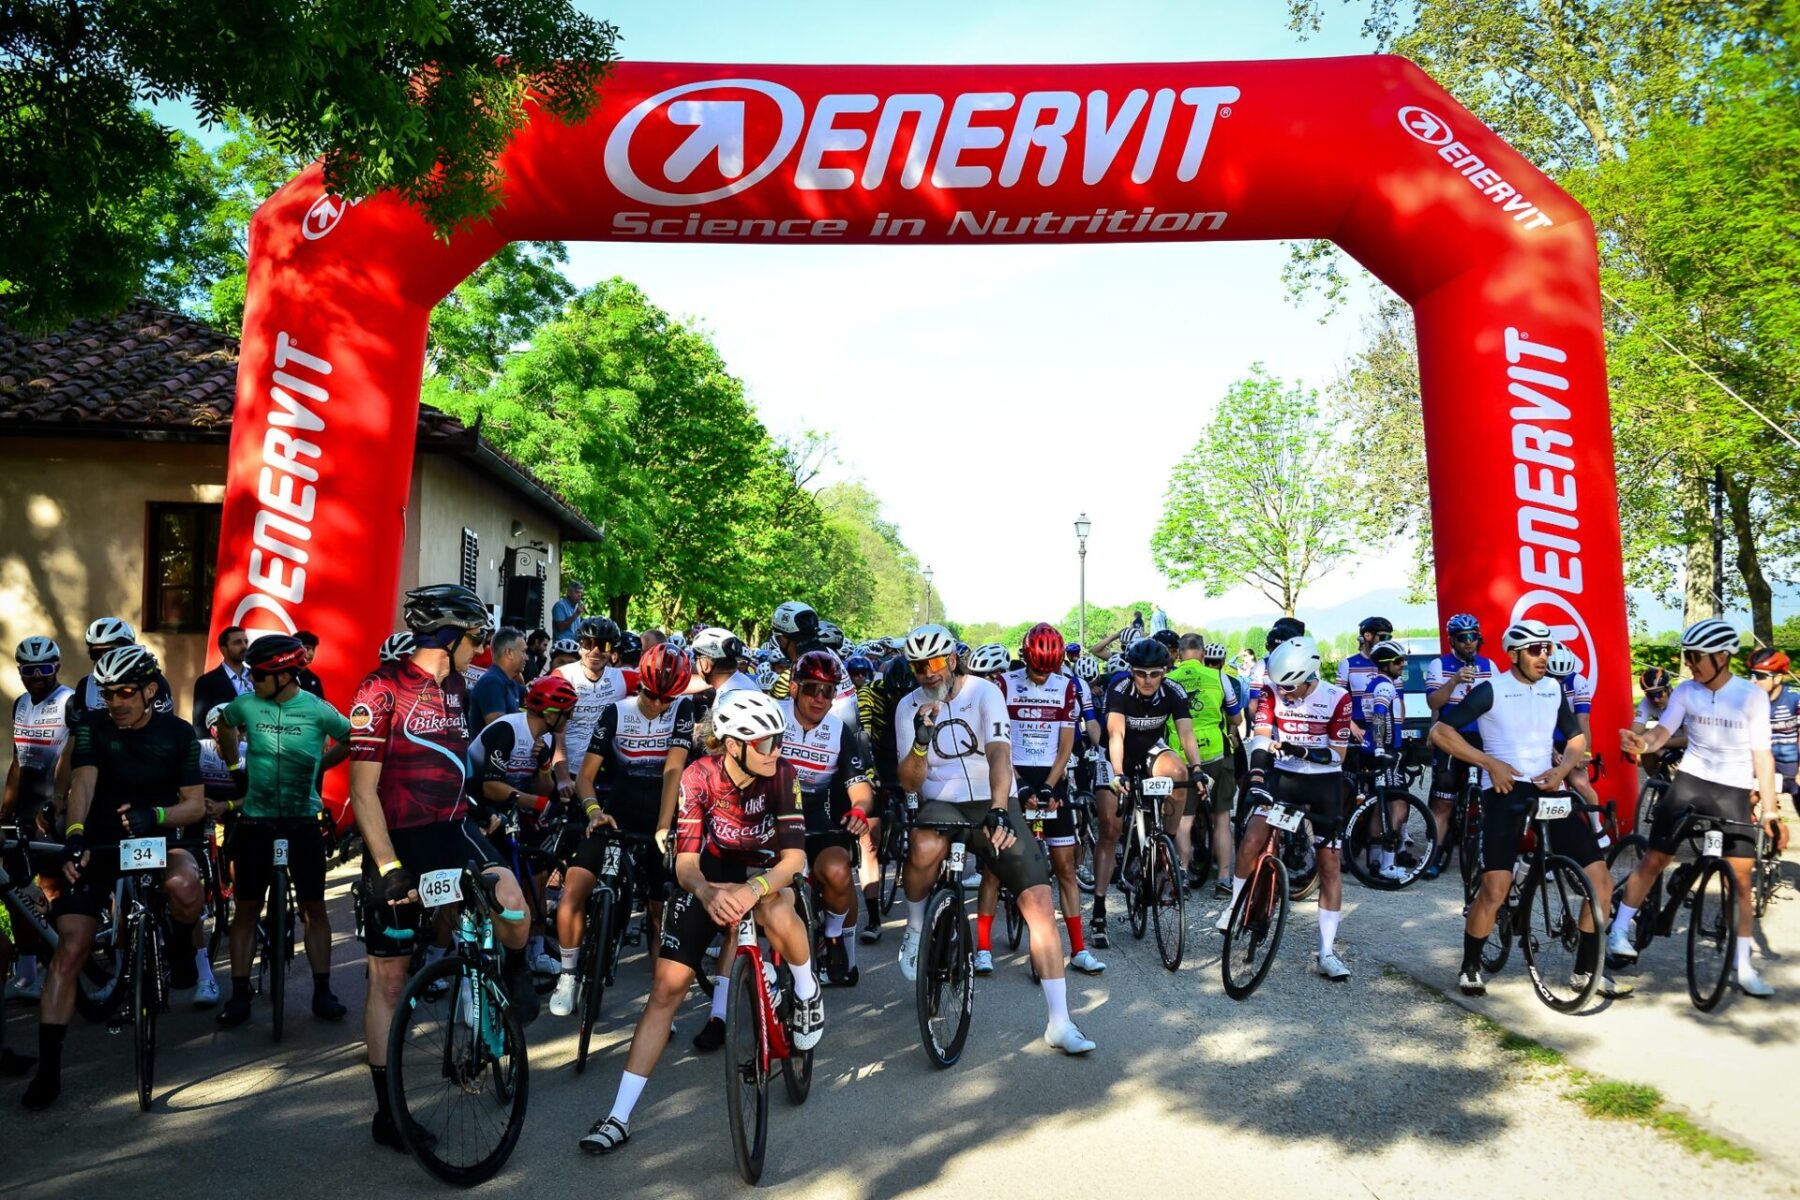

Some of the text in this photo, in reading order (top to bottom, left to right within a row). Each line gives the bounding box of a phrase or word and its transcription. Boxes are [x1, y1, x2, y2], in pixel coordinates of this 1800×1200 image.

[794, 86, 1241, 190] ENERVIT
[1437, 141, 1553, 231] ENERVIT
[611, 207, 1228, 237] Science in Nutrition
[248, 331, 333, 604] ENERVIT
[1504, 326, 1584, 594] ENERVIT
[255, 723, 302, 732] ORBEA
[409, 712, 467, 731] Bikecaf
[14, 727, 55, 738] EROSEI
[620, 738, 668, 748] ZEROS
[781, 746, 830, 763] EROSEI
[1149, 781, 1167, 790] 267
[1545, 805, 1564, 815] 166
[1279, 815, 1291, 824] 14
[133, 848, 153, 861] 34
[426, 879, 451, 897] 485
[739, 921, 754, 936] 21
[470, 967, 480, 1020] Bianchi
